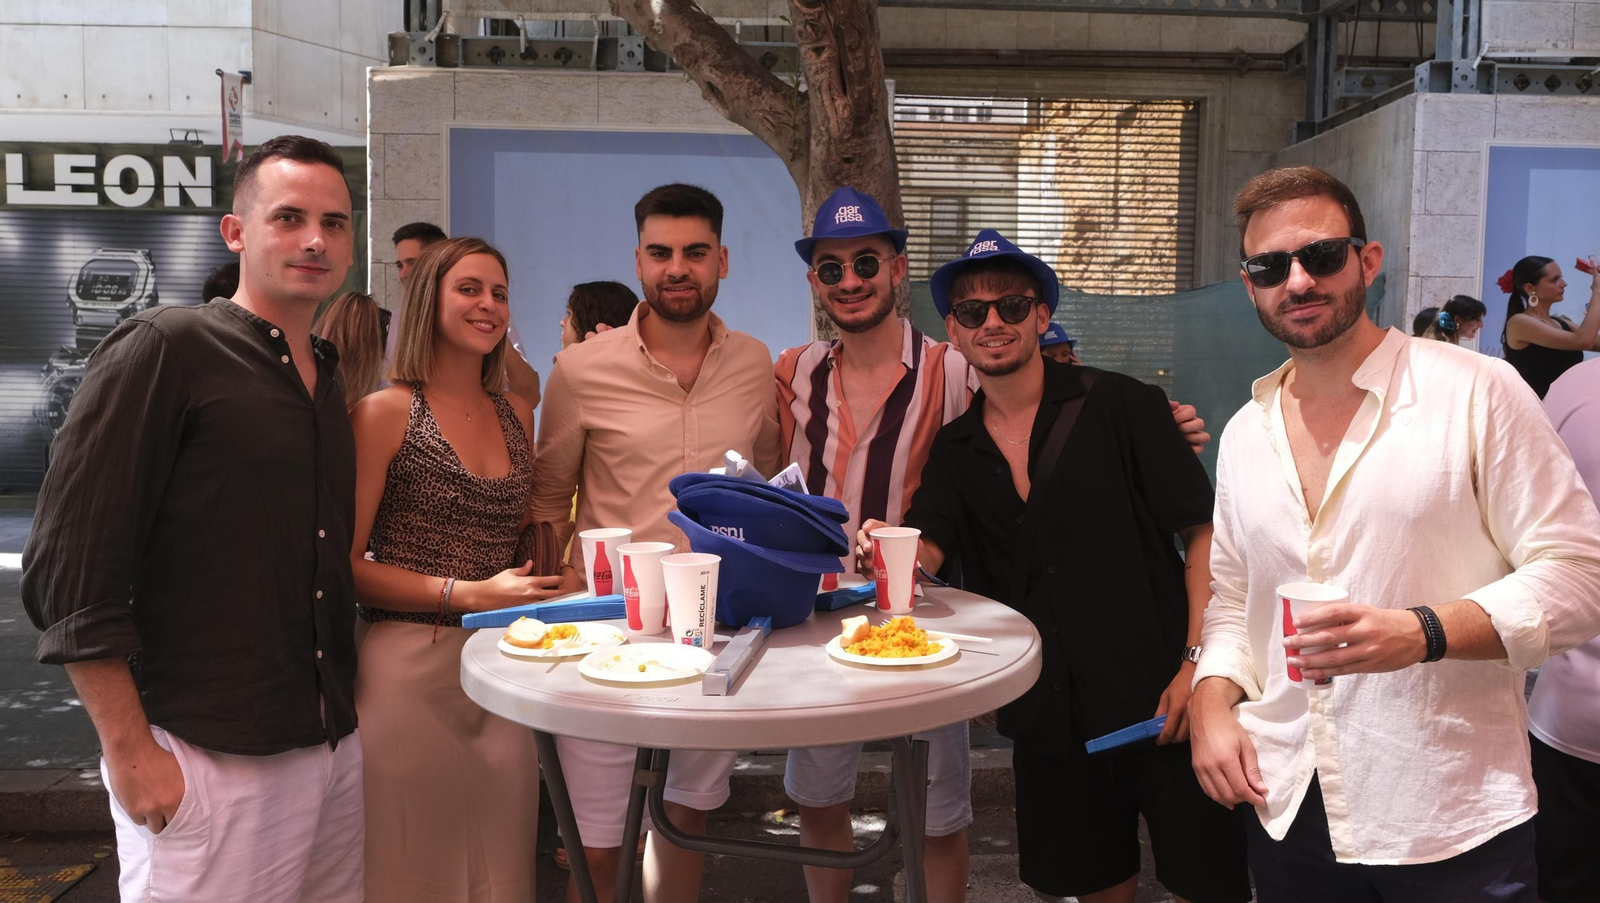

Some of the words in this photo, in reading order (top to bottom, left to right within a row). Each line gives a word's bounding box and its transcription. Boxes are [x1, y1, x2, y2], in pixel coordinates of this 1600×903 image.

[5, 153, 213, 207] LEON
[838, 205, 860, 217] gar
[974, 240, 997, 252] gar
